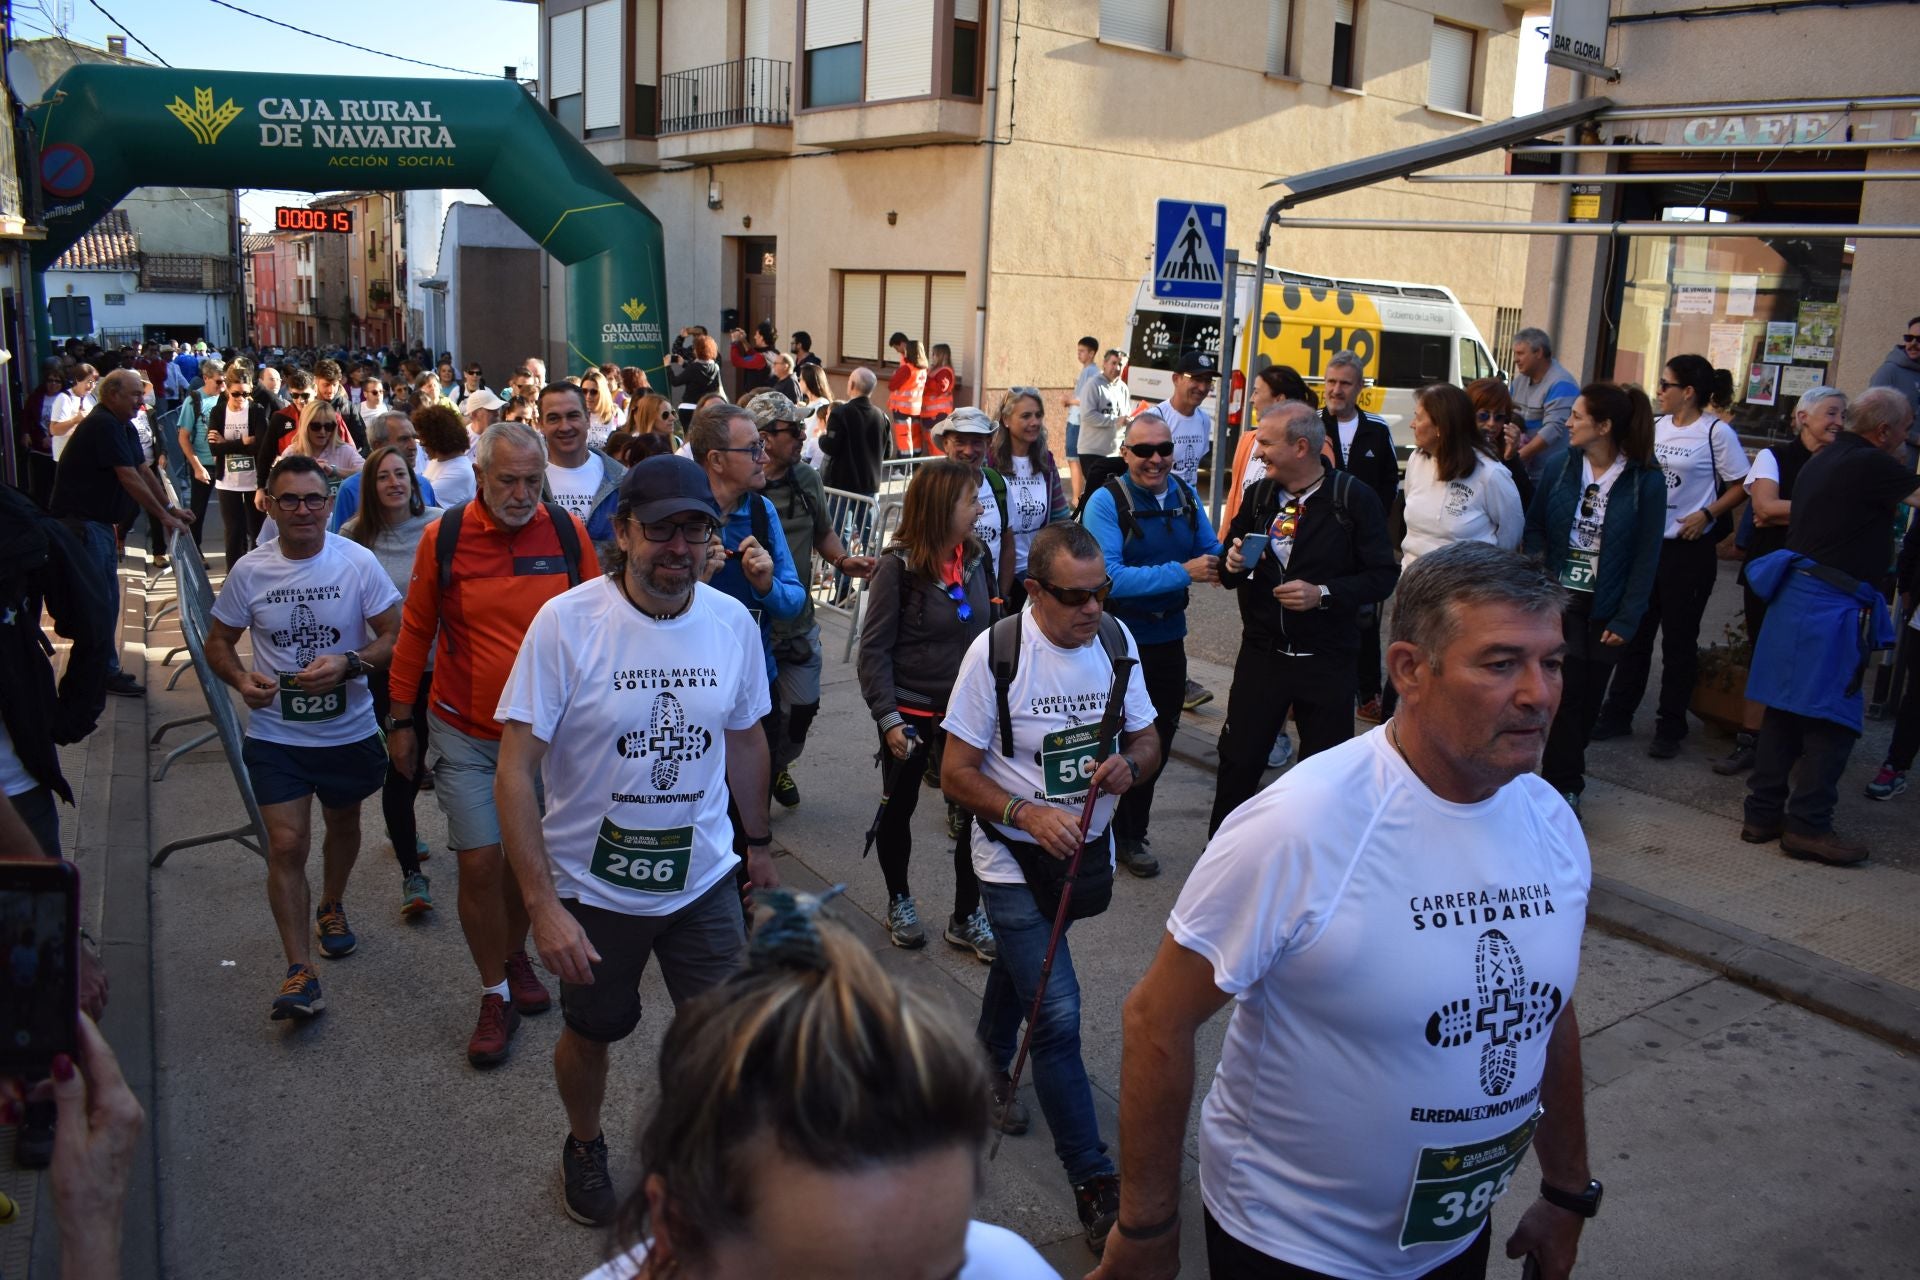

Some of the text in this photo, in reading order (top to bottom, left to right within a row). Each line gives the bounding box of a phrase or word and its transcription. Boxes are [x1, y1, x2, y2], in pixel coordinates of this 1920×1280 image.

[1554, 34, 1601, 60] BAR GLORIA
[258, 97, 442, 123] CAJA RURAL
[259, 123, 456, 148] DE NAVARRA
[328, 153, 455, 167] ACCIÓN SOCIAL
[42, 201, 86, 221] anMiguel
[1158, 300, 1220, 311] ambulancia
[1386, 308, 1414, 321] Gobierno
[1415, 312, 1422, 321] de
[1422, 312, 1429, 322] La
[602, 323, 661, 334] CAJA RURAL
[601, 333, 617, 343] DE
[1152, 331, 1170, 346] 112
[230, 460, 251, 470] 345
[1569, 566, 1594, 584] 57
[266, 585, 341, 597] CARRERA-MARCHA
[266, 592, 341, 604] SOLIDARIA
[613, 667, 718, 681] CARRERA-MARCHA
[614, 678, 718, 691] SOLIDARIA
[291, 693, 339, 714] 628
[605, 853, 675, 882] 266
[1410, 883, 1551, 912] CARRERA-MARCHA
[1413, 900, 1555, 930] SOLIDARIA
